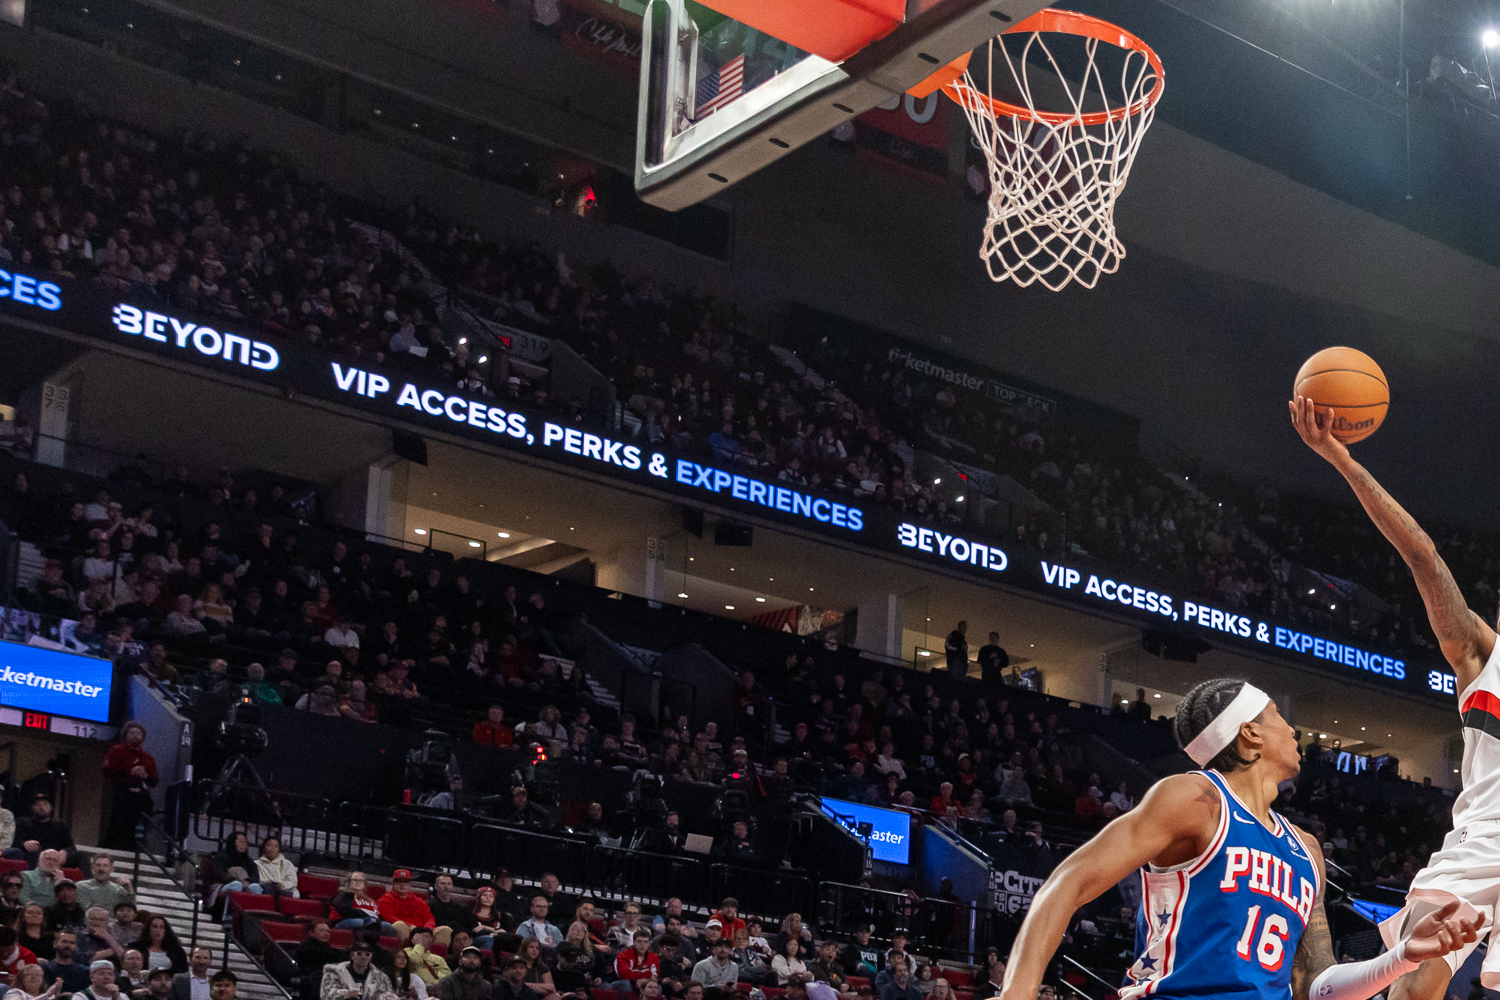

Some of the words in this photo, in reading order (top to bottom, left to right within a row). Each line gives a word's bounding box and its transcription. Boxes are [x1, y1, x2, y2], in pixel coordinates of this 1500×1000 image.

[332, 363, 389, 398] VIP
[397, 384, 534, 445] ACCESS,
[544, 423, 641, 469] PERKS
[649, 453, 668, 478] &
[676, 460, 866, 530] EXPERIENCES
[1041, 561, 1080, 588] VIP
[1085, 575, 1178, 621] ACCESS,
[1184, 602, 1251, 637] PERKS
[1256, 623, 1269, 643] &
[1275, 627, 1405, 679] EXPERIENCES
[24, 709, 47, 727] EXIT
[1220, 846, 1315, 929] PHILA
[1236, 904, 1289, 972] 16
